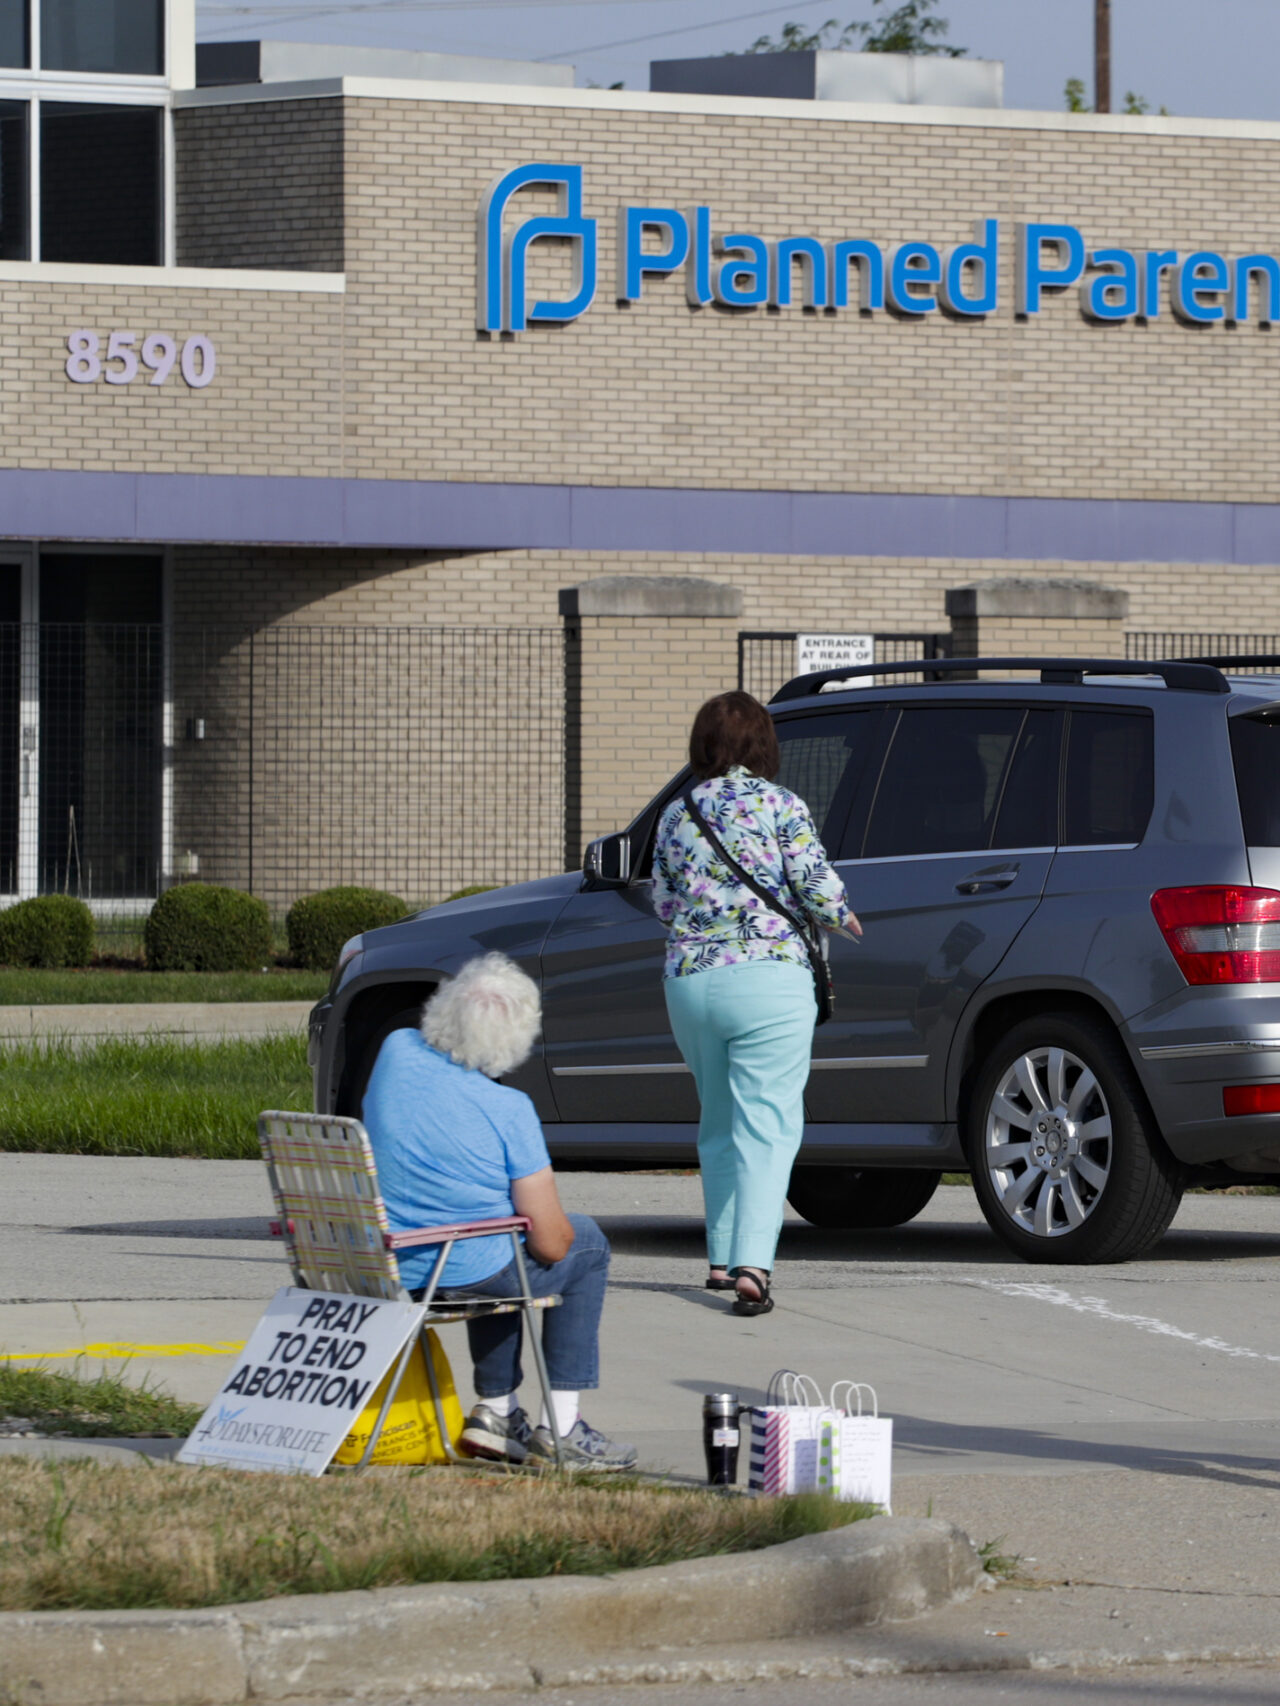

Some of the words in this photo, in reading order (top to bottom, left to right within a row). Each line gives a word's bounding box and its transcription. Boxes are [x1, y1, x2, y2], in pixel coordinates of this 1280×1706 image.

[624, 206, 998, 315] Planned
[66, 330, 217, 388] 8590
[801, 650, 815, 660] AT
[819, 650, 850, 660] REAR
[854, 650, 871, 660] OF
[804, 638, 866, 648] ENTRANCE
[297, 1297, 379, 1334] PRAY
[267, 1331, 307, 1363] TO
[303, 1336, 367, 1371] END
[222, 1363, 373, 1411] ABORTION
